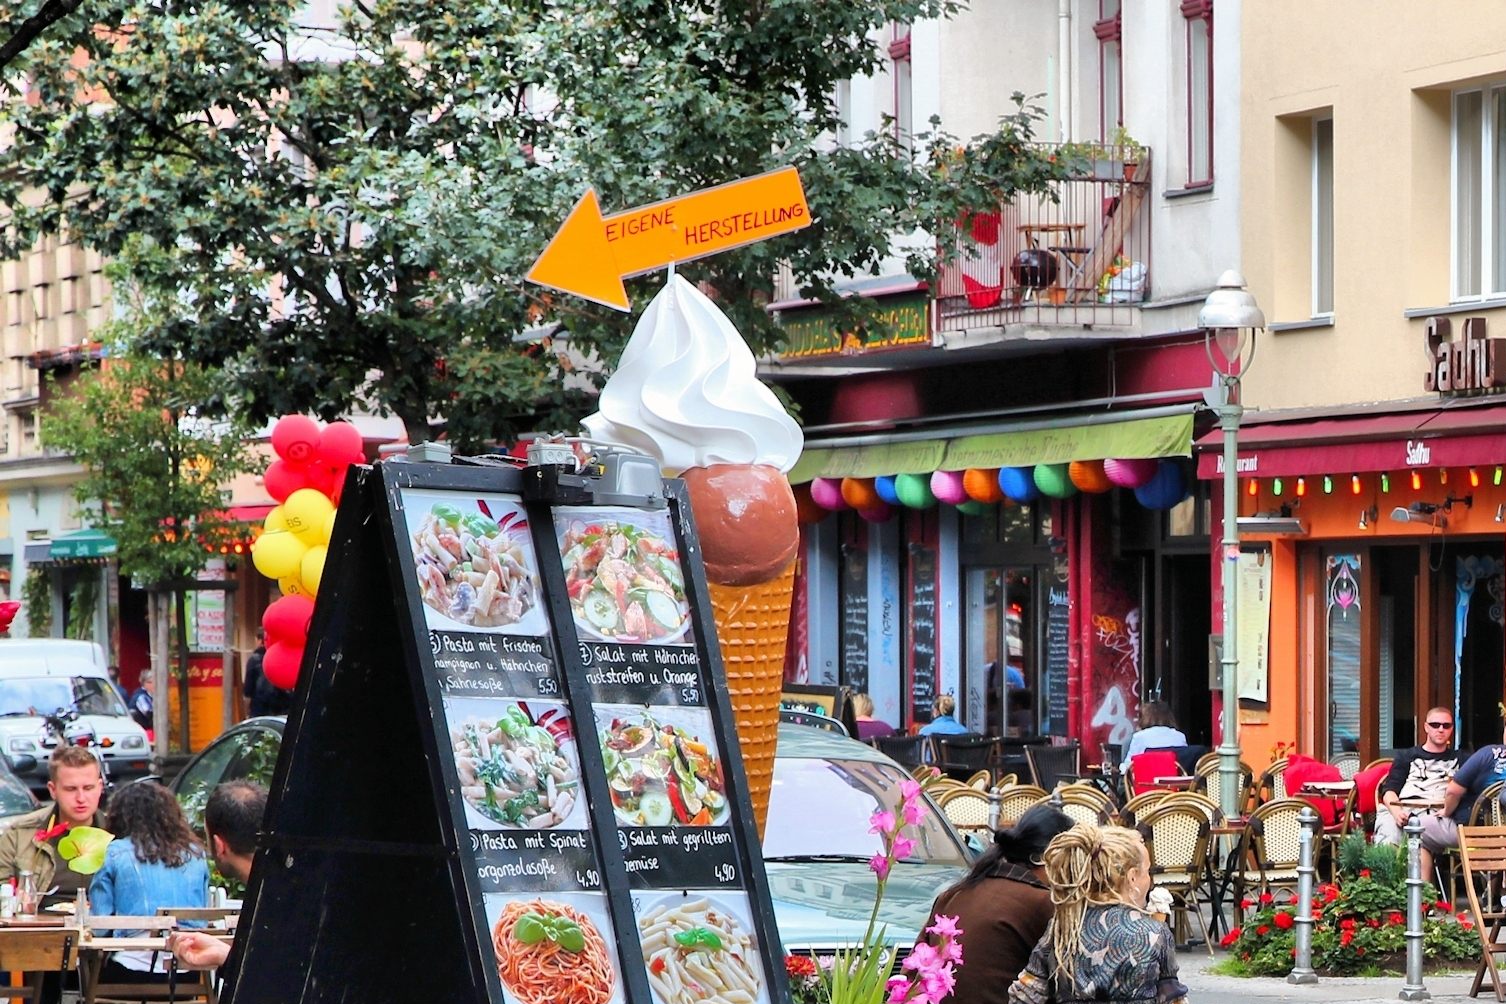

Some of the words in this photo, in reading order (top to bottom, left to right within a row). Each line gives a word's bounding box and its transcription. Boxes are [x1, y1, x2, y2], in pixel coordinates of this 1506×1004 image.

[606, 206, 676, 242] EIGENE
[685, 203, 804, 246] HERSTELLUNG
[1424, 317, 1504, 392] Sadhu
[1406, 440, 1430, 465] Sadhu
[443, 635, 475, 653] Pasta
[478, 636, 497, 653] mit
[503, 637, 542, 653] frischen
[594, 646, 626, 663] Salat
[632, 649, 649, 663] mit
[501, 658, 548, 673] Hähnchen
[538, 679, 557, 694] 5,50
[663, 668, 698, 688] Orange
[682, 689, 699, 703] 5,50
[482, 833, 518, 850] Pasta
[525, 832, 545, 848] mit
[549, 832, 586, 854] Spinat
[629, 831, 658, 846] Salat
[662, 830, 679, 845] mit
[576, 870, 600, 887] 4,90
[714, 863, 735, 882] 4,90
